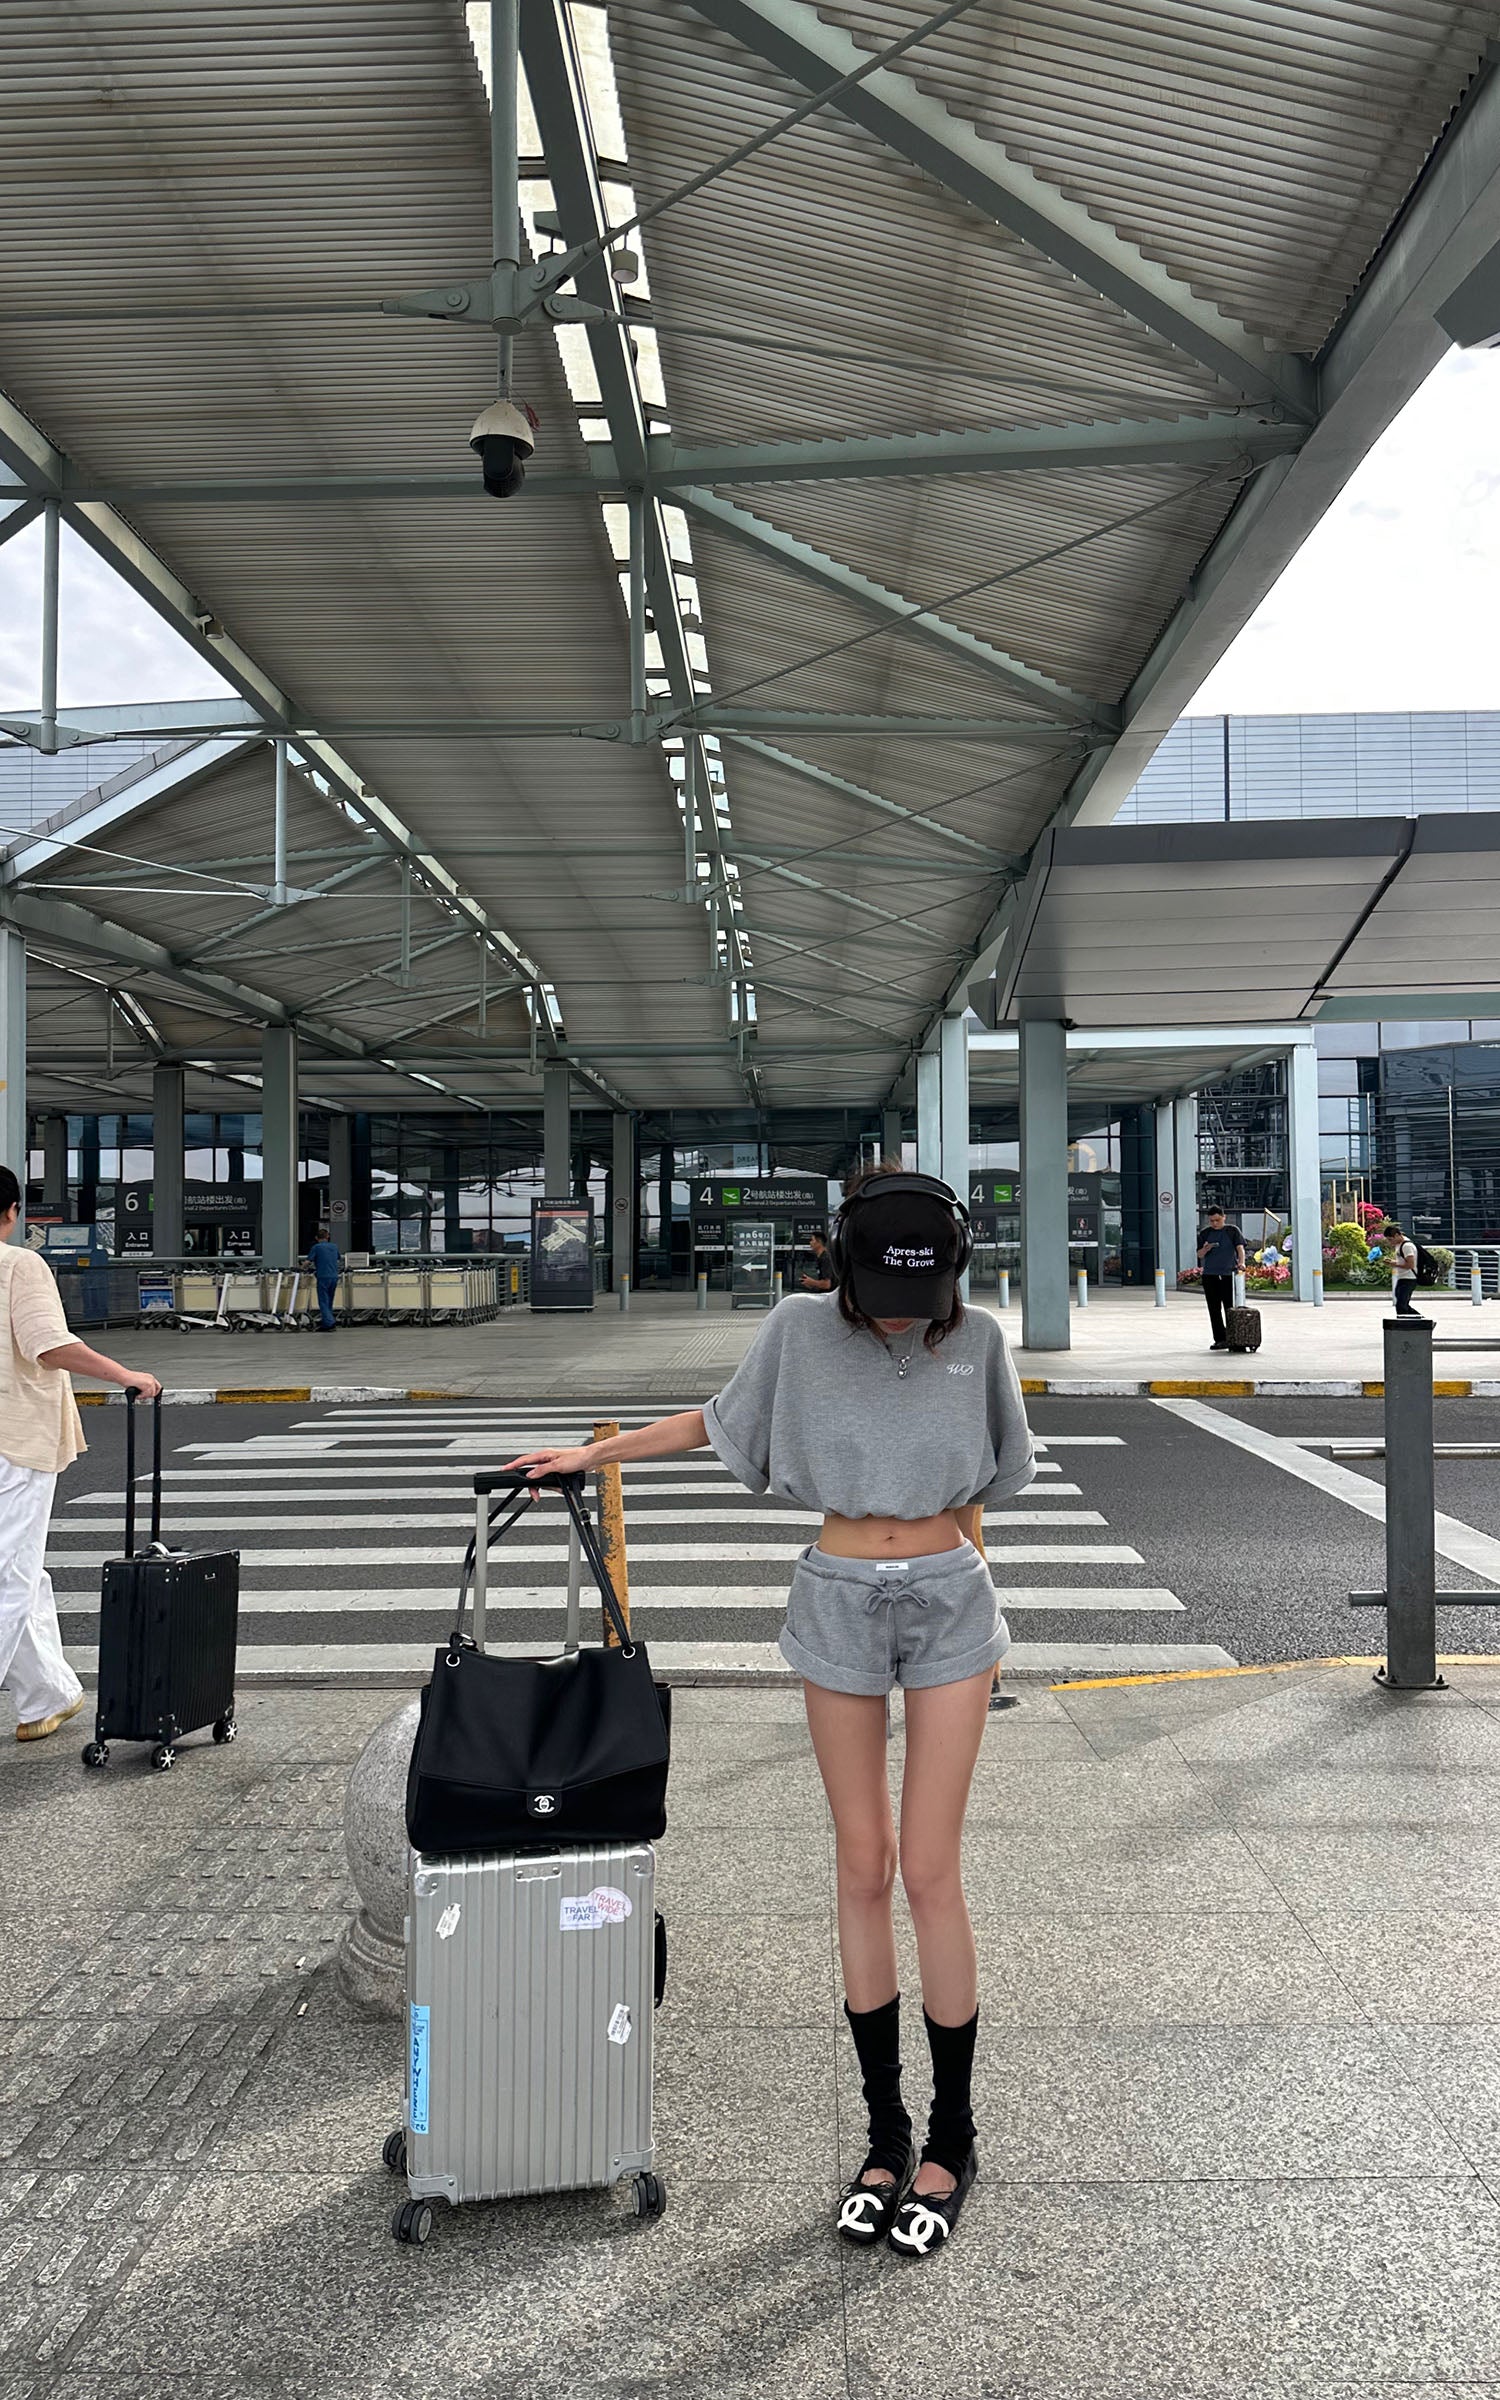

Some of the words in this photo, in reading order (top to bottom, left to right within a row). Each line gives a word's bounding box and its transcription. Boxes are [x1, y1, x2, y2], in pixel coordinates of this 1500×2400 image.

[699, 1186, 714, 1205] 4
[970, 1184, 985, 1203] 4
[125, 1191, 139, 1211] 6
[127, 1232, 149, 1240] 入口
[229, 1231, 250, 1240] 入口
[886, 1245, 933, 1256] Apres-ski
[883, 1255, 903, 1266] The
[907, 1258, 935, 1267] Grove
[595, 1893, 626, 1911] TRAVEL
[564, 1905, 599, 1914] TRAVEL
[598, 1903, 619, 1915] WIDE
[572, 1913, 591, 1921] FAR
